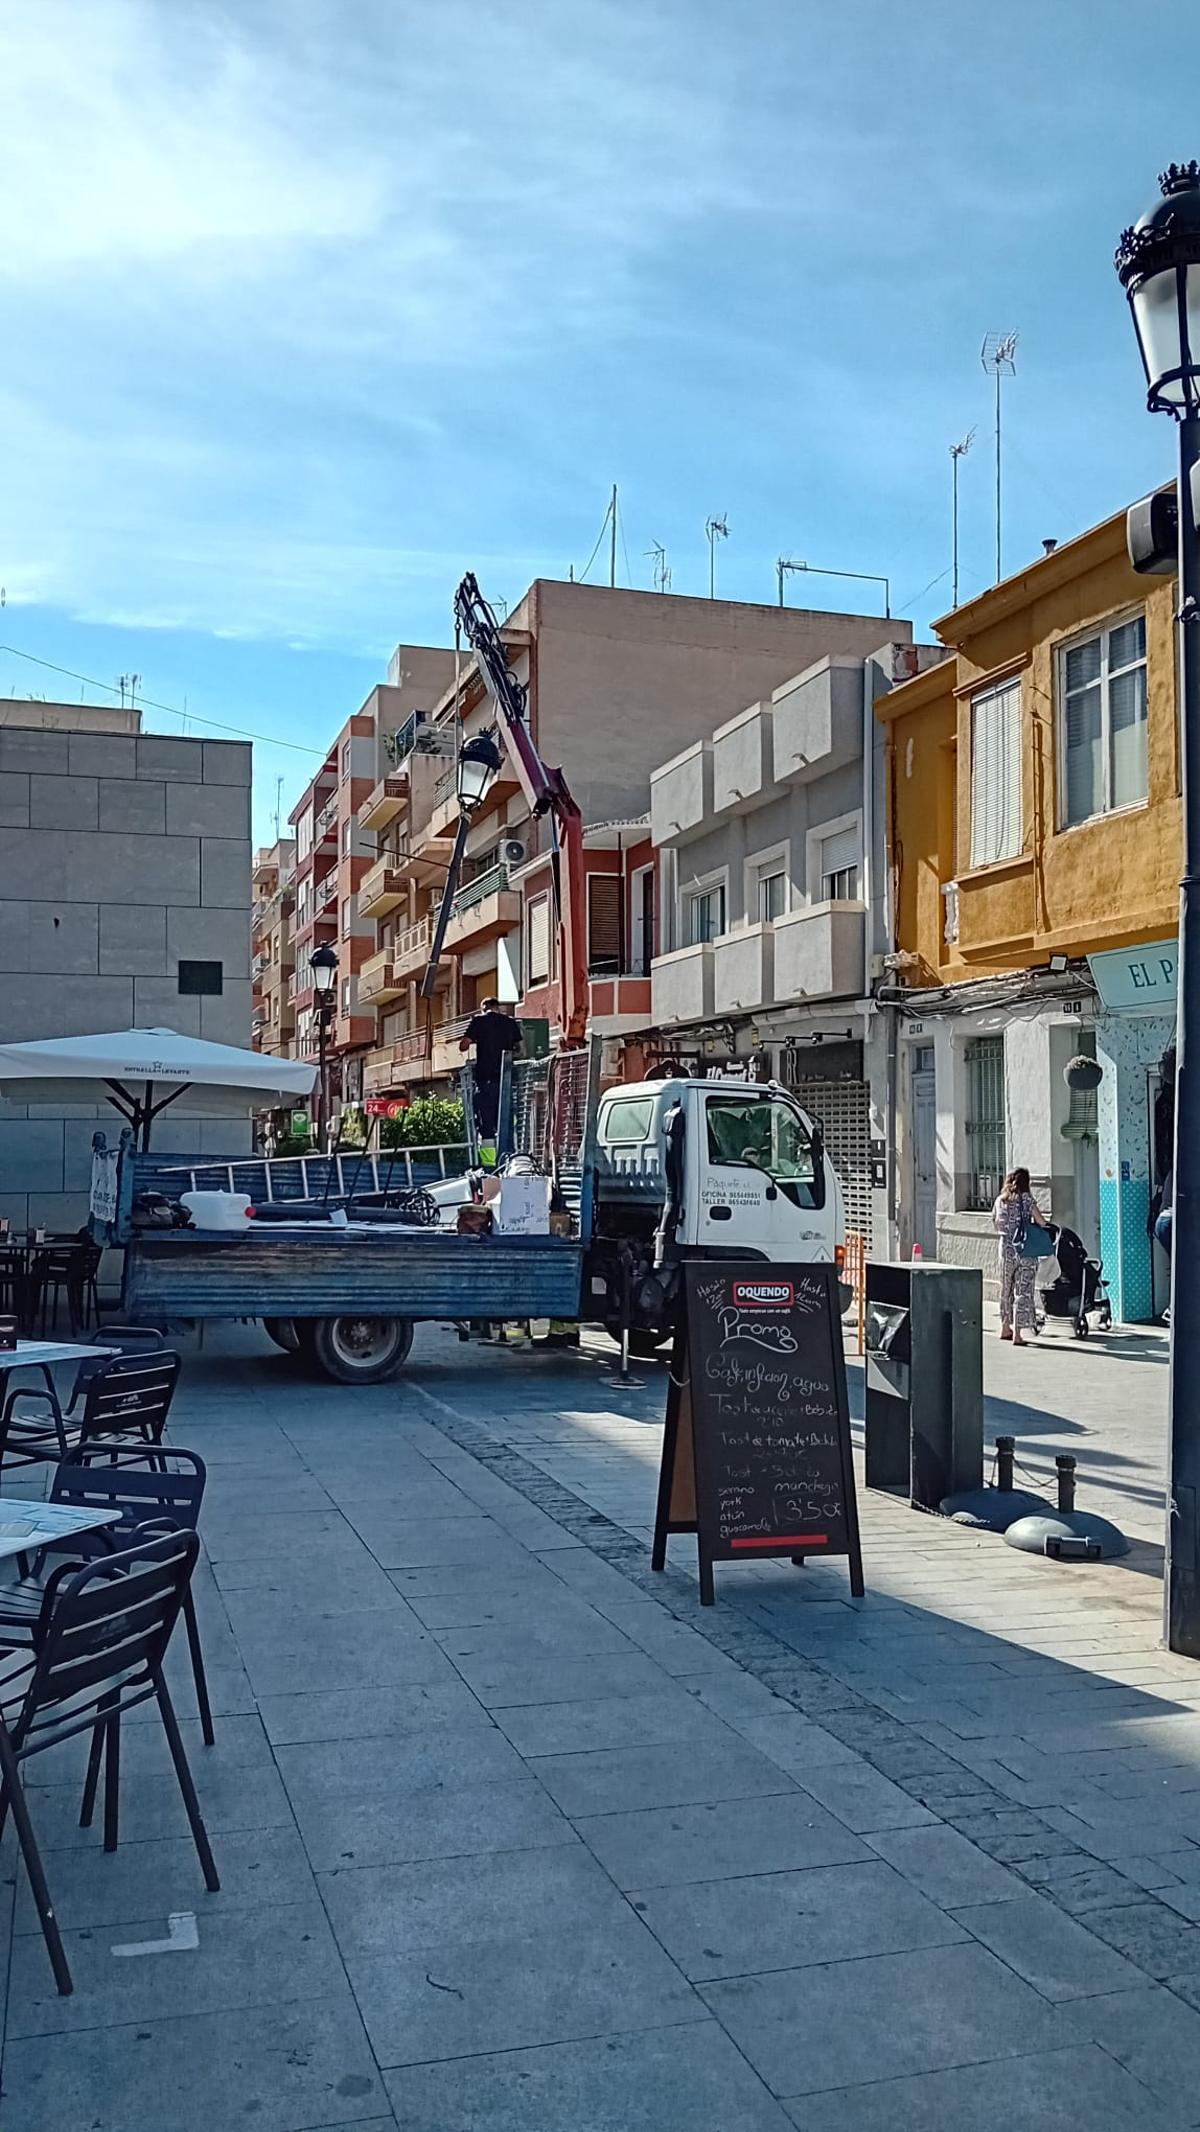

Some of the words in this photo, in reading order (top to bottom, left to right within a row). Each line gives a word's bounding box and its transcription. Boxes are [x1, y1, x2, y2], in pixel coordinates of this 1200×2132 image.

[1128, 963, 1157, 988] EL
[367, 1104, 379, 1113] 24
[737, 1286, 790, 1299] OQUENDO
[717, 1306, 794, 1343] Promo
